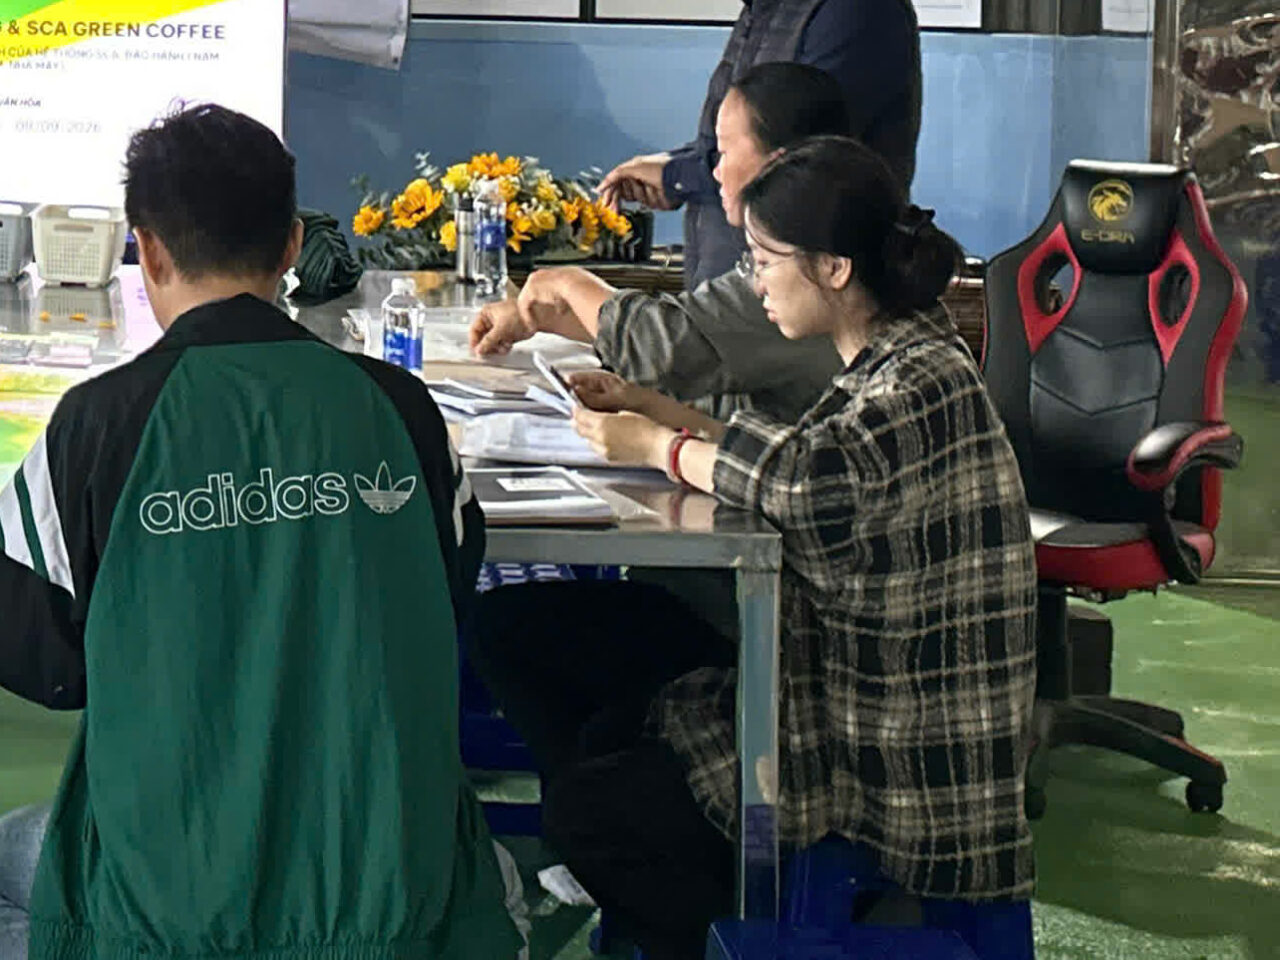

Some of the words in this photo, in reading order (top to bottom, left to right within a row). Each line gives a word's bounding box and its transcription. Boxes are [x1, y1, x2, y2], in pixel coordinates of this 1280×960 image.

[7, 19, 20, 35] &
[27, 20, 67, 36] SCA
[73, 21, 140, 37] GREEN
[146, 23, 226, 39] COFFEE
